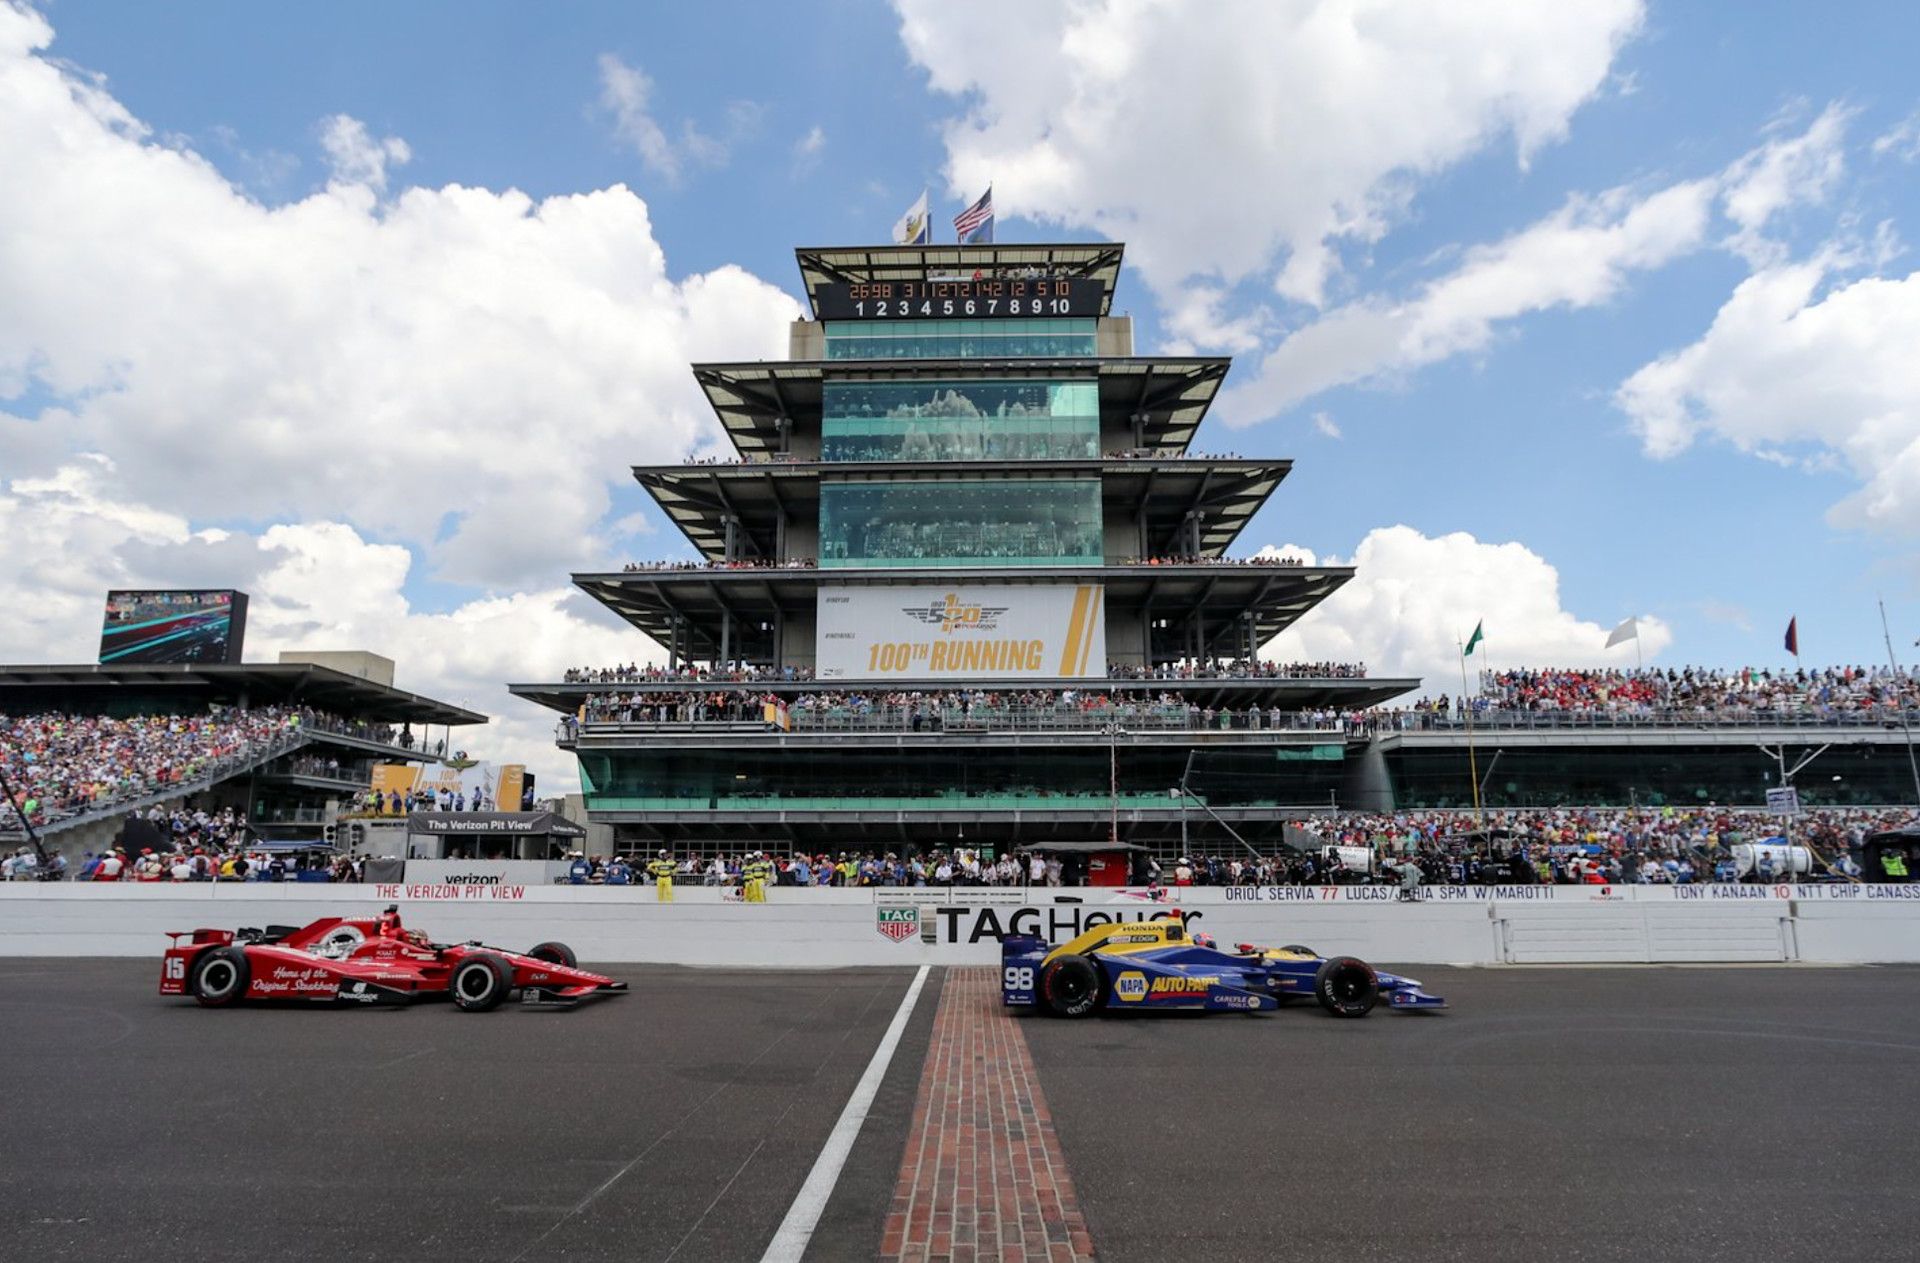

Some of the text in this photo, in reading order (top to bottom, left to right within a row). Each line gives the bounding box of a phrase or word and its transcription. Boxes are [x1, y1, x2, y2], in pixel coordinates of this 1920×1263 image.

[850, 284, 869, 299] 26
[873, 284, 891, 299] 98
[904, 284, 914, 298] 3
[983, 283, 1002, 297] 42
[1010, 282, 1025, 297] 12
[1037, 282, 1047, 296] 5
[1055, 281, 1069, 296] 10
[855, 299, 1070, 316] 1 2 3 4 5 6 7 8 9 10
[929, 640, 1044, 673] RUNNING
[428, 819, 533, 830] The Verizon Pit View
[445, 873, 499, 885] verizon
[376, 884, 526, 899] THE VERIZON PIT VIEW
[1225, 887, 1263, 901] ORIOL
[1269, 887, 1315, 901] SERVIA
[1321, 887, 1340, 901] 77
[1439, 886, 1468, 900] SPM
[1474, 886, 1555, 900] W/MAROTTI
[1672, 886, 1705, 899] TONY
[1712, 886, 1767, 899] KANAAN
[1773, 886, 1791, 899] 10
[1797, 886, 1823, 899] NTT
[1830, 886, 1861, 899] CHIP
[882, 910, 915, 921] TAG
[879, 922, 915, 940] HEUER
[165, 957, 185, 980] 15
[273, 966, 329, 981] Home of the
[252, 978, 289, 993] Original
[1004, 966, 1034, 990] 98
[1120, 978, 1144, 993] NAPA
[1151, 977, 1184, 992] AUTO
[1214, 995, 1247, 1003] CARLYLE
